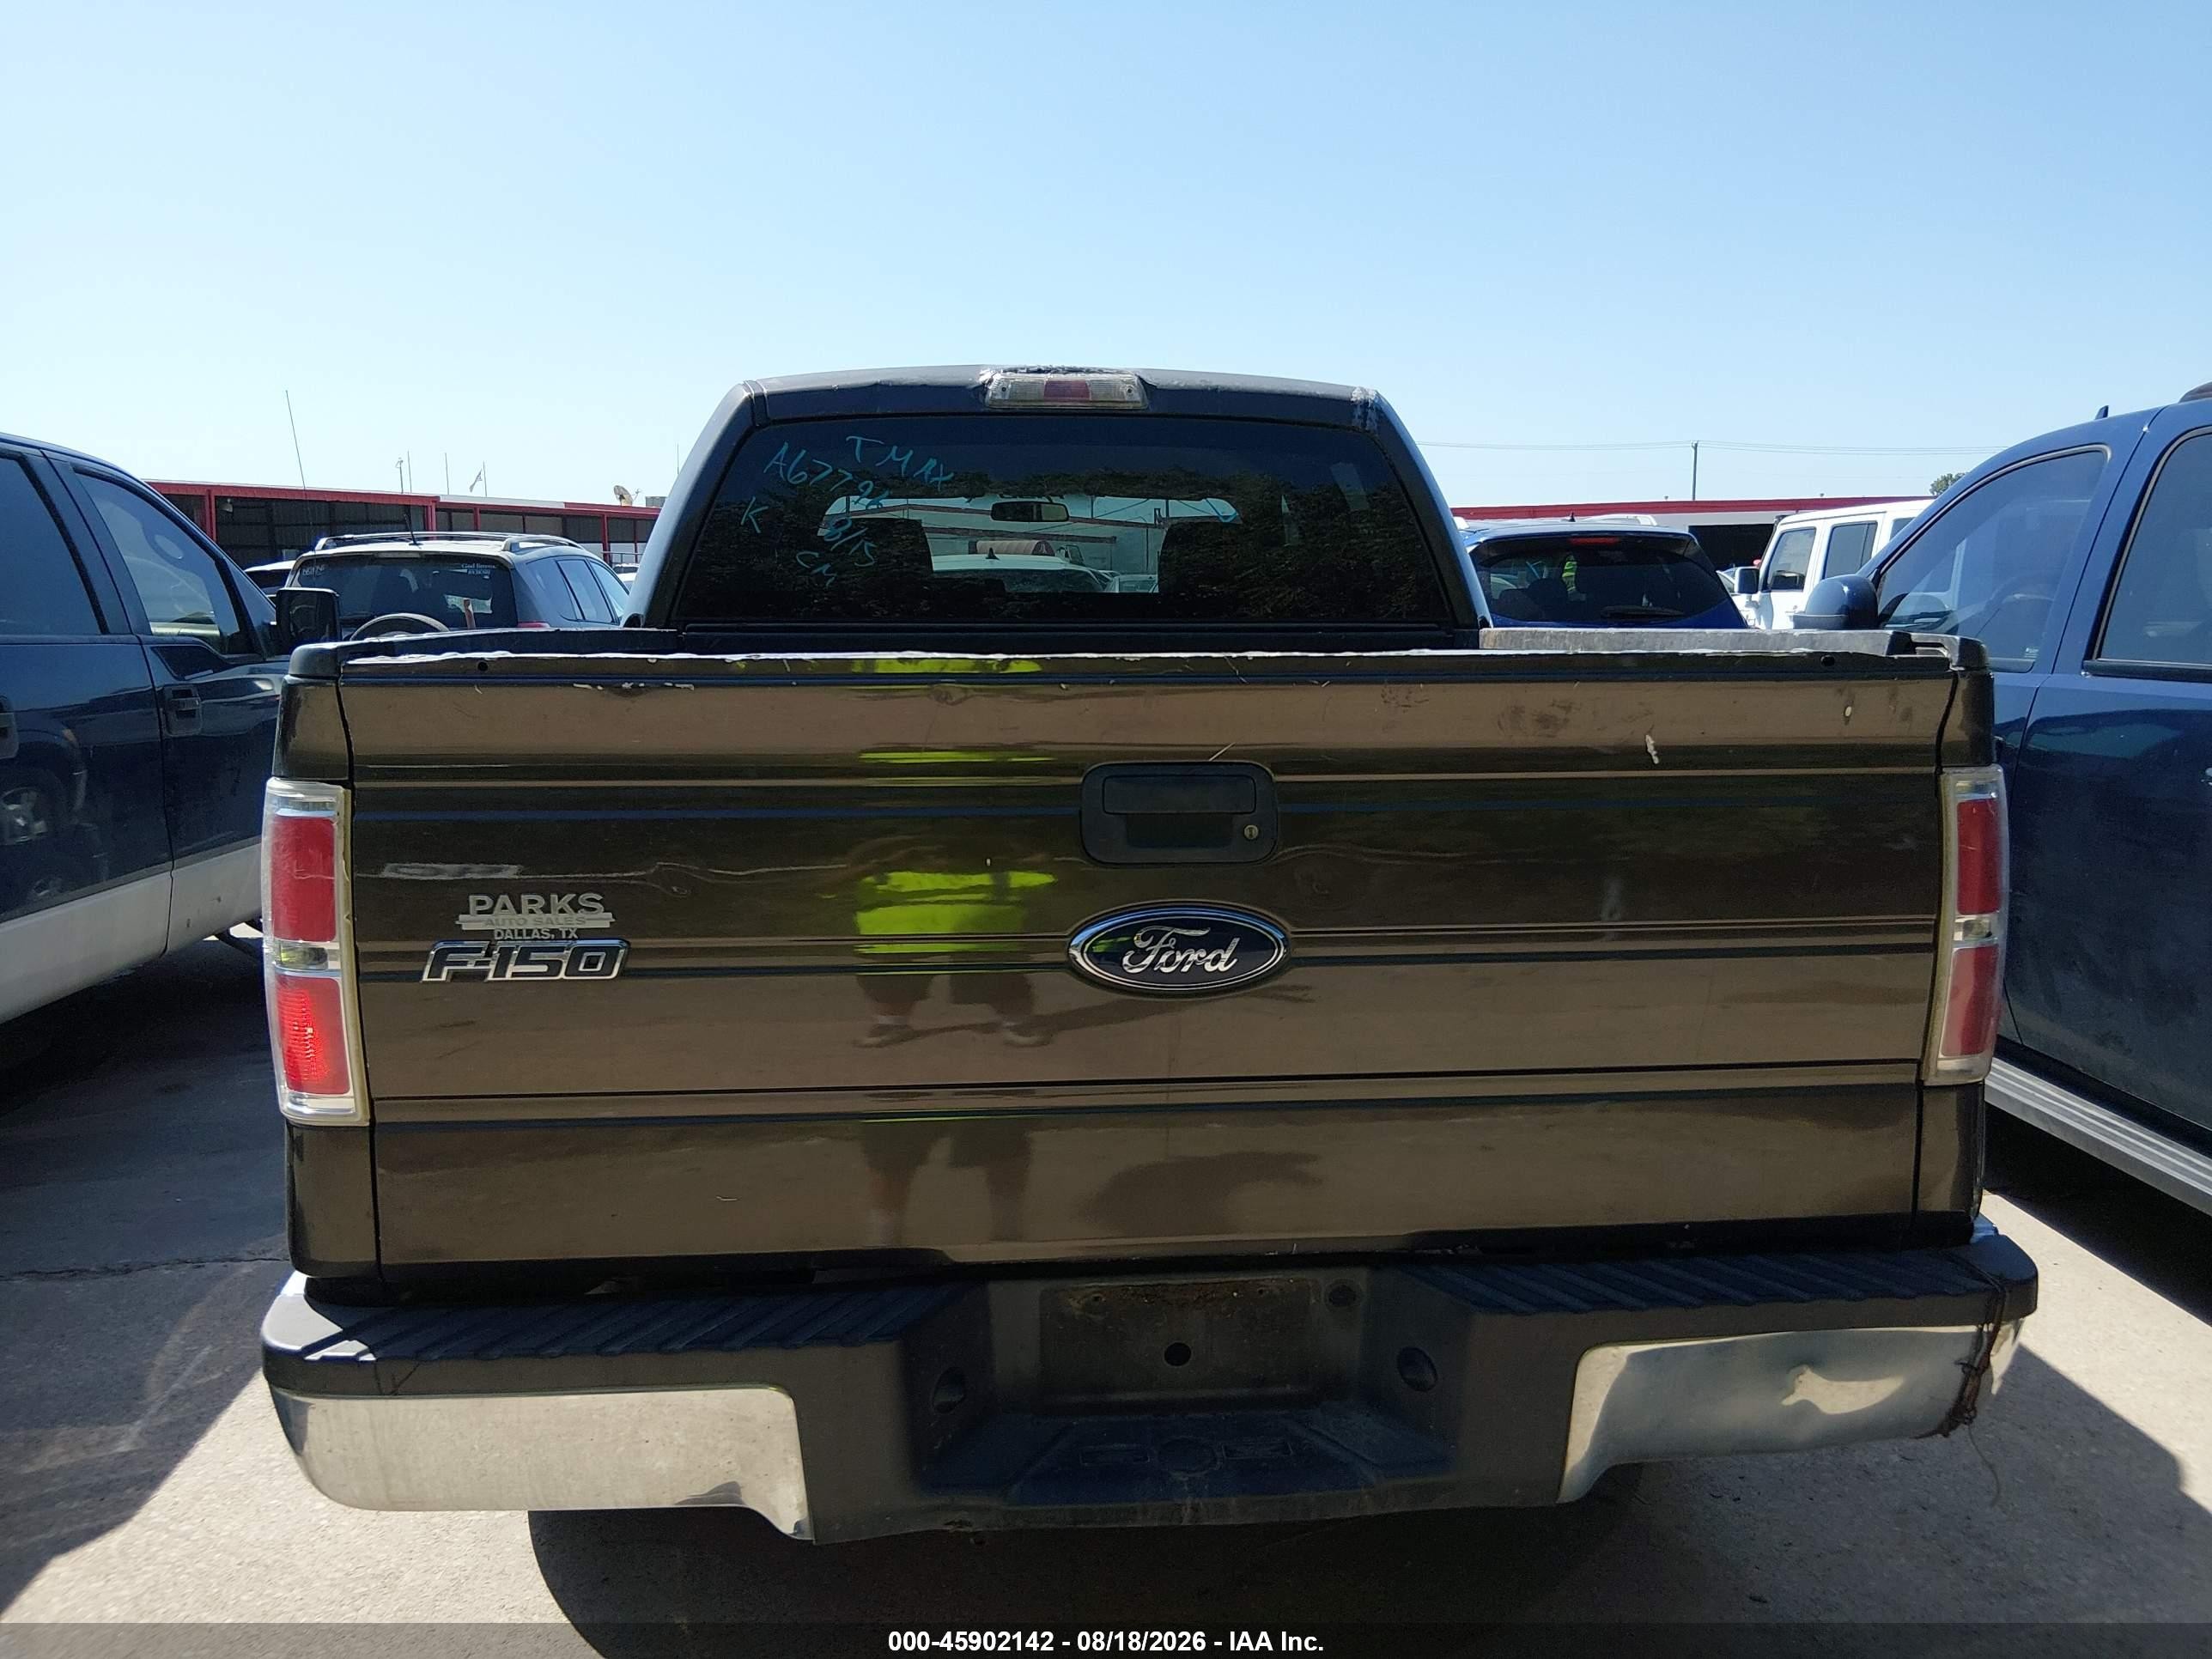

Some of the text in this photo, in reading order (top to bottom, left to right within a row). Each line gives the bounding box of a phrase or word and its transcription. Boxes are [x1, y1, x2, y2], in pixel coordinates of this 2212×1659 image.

[740, 495, 769, 533] K
[468, 893, 605, 916] PARKS
[484, 916, 586, 927] AUTO SALES
[494, 927, 579, 940] DALLAS, TX
[1121, 925, 1241, 974] Ford
